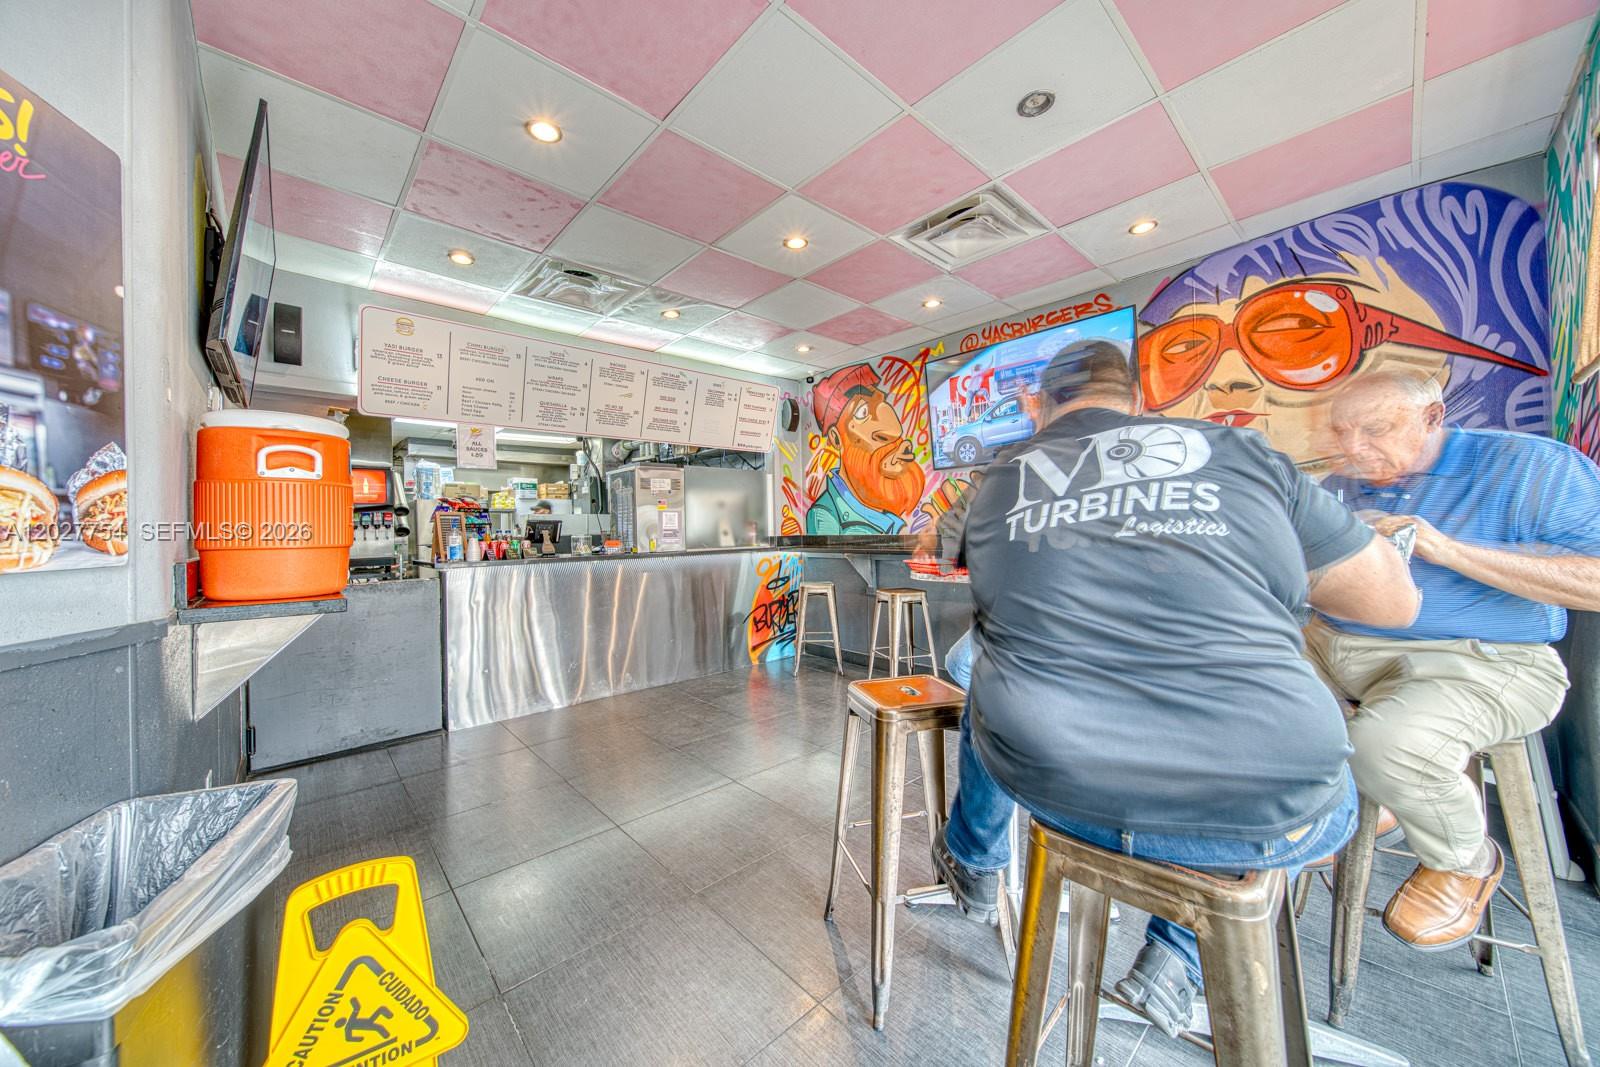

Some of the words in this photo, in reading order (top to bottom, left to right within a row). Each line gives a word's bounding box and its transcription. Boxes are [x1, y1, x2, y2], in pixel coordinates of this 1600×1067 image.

[1006, 480, 1222, 542] TURBINES
[1113, 515, 1231, 539] Logistics
[378, 971, 430, 1022] CUIDADO
